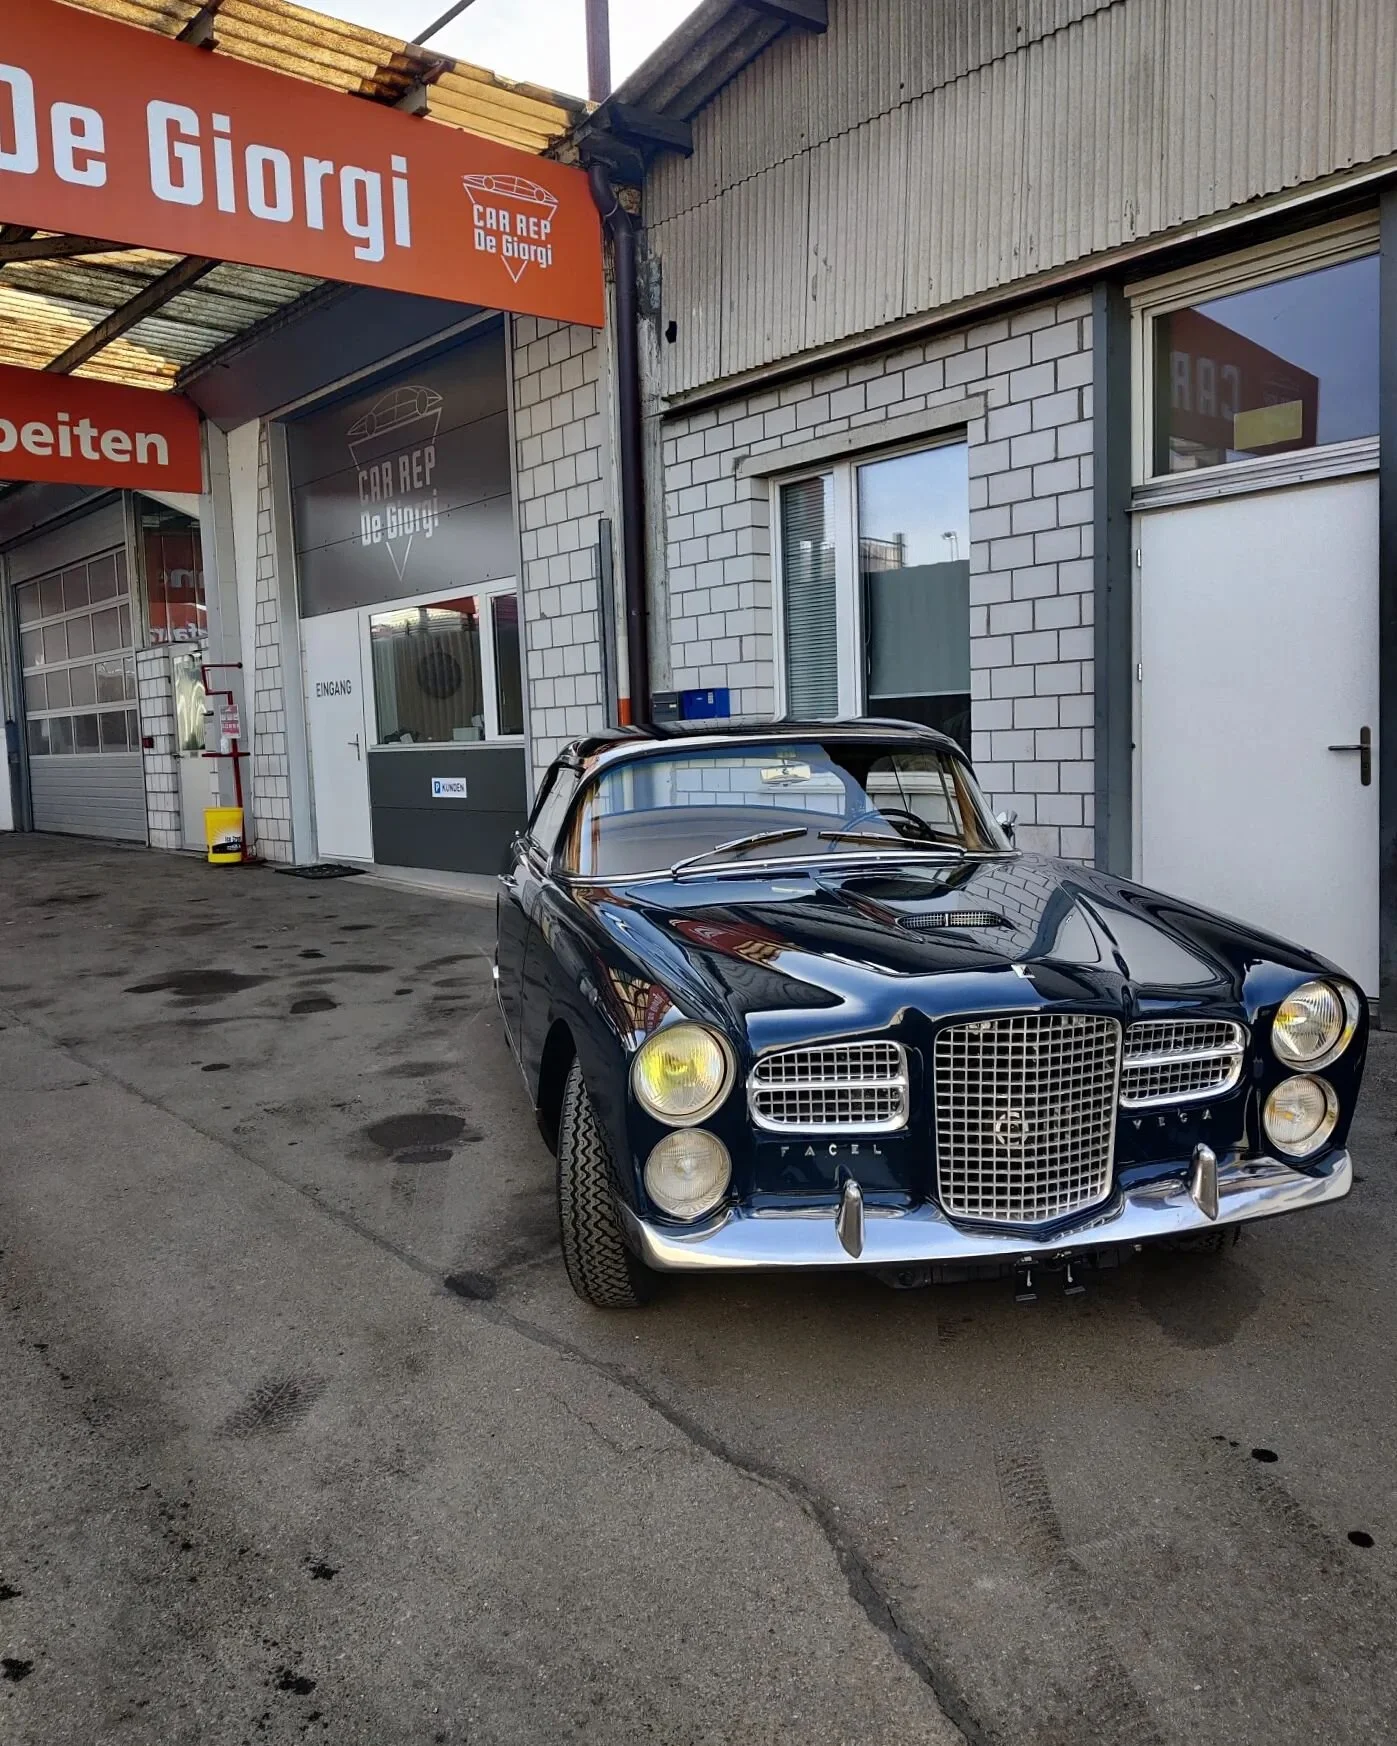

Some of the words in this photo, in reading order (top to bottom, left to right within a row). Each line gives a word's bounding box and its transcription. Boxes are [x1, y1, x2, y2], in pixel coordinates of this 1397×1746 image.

[0, 63, 108, 188] De
[146, 99, 411, 263] Giorgi
[473, 203, 510, 233] CAR
[516, 213, 551, 241] REP
[474, 228, 497, 254] De
[502, 234, 552, 269] Giorgi
[358, 461, 393, 506] CAR
[398, 445, 436, 494] REP
[360, 510, 381, 546] De
[386, 488, 439, 538] Giorgi
[316, 679, 352, 698] EINGANG
[442, 782, 465, 793] KUNDEN
[1132, 1108, 1212, 1130] VEGA
[780, 1143, 882, 1158] FACEL
